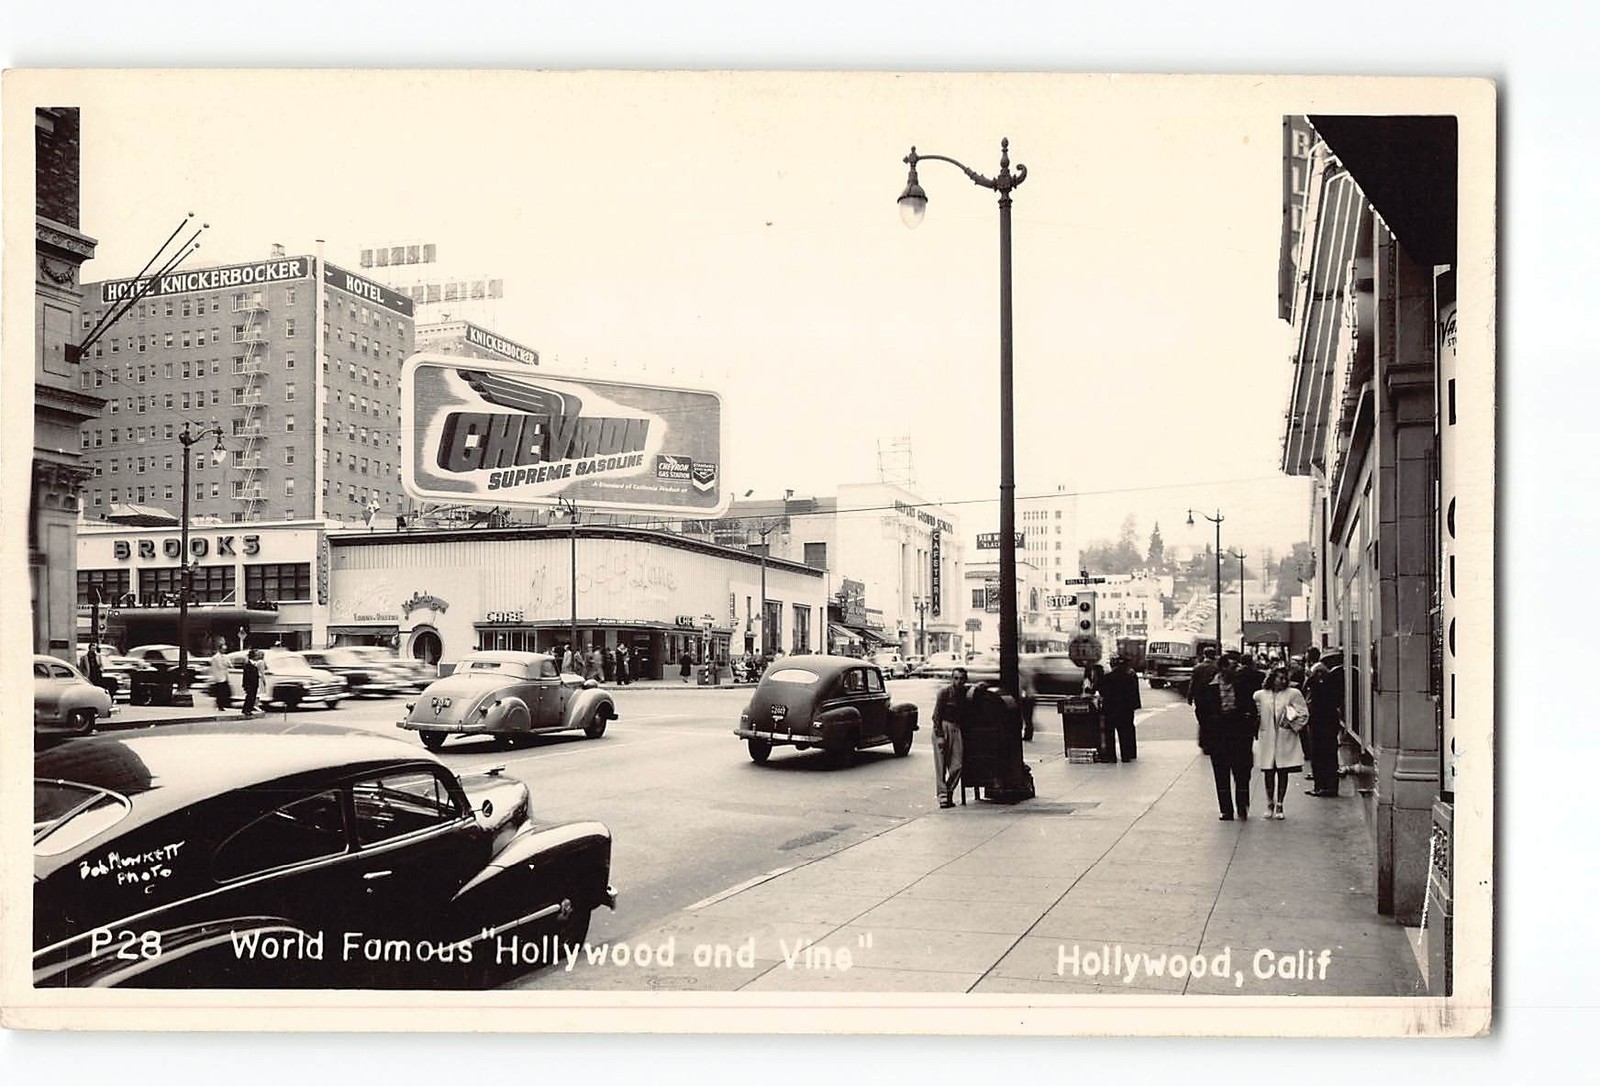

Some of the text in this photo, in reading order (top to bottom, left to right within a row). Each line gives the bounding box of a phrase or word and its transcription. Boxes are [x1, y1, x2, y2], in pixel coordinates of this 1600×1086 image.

[160, 261, 301, 294] KNICKERBOCKER
[345, 275, 385, 304] HOTEL
[470, 327, 536, 366] KNICKERBOCKER
[437, 411, 650, 474] CHEVRON
[488, 454, 644, 491] SUPREME GASOLINE
[114, 535, 260, 560] BROOKS
[933, 533, 942, 616] CAFETERIA
[1048, 596, 1073, 606] STOP
